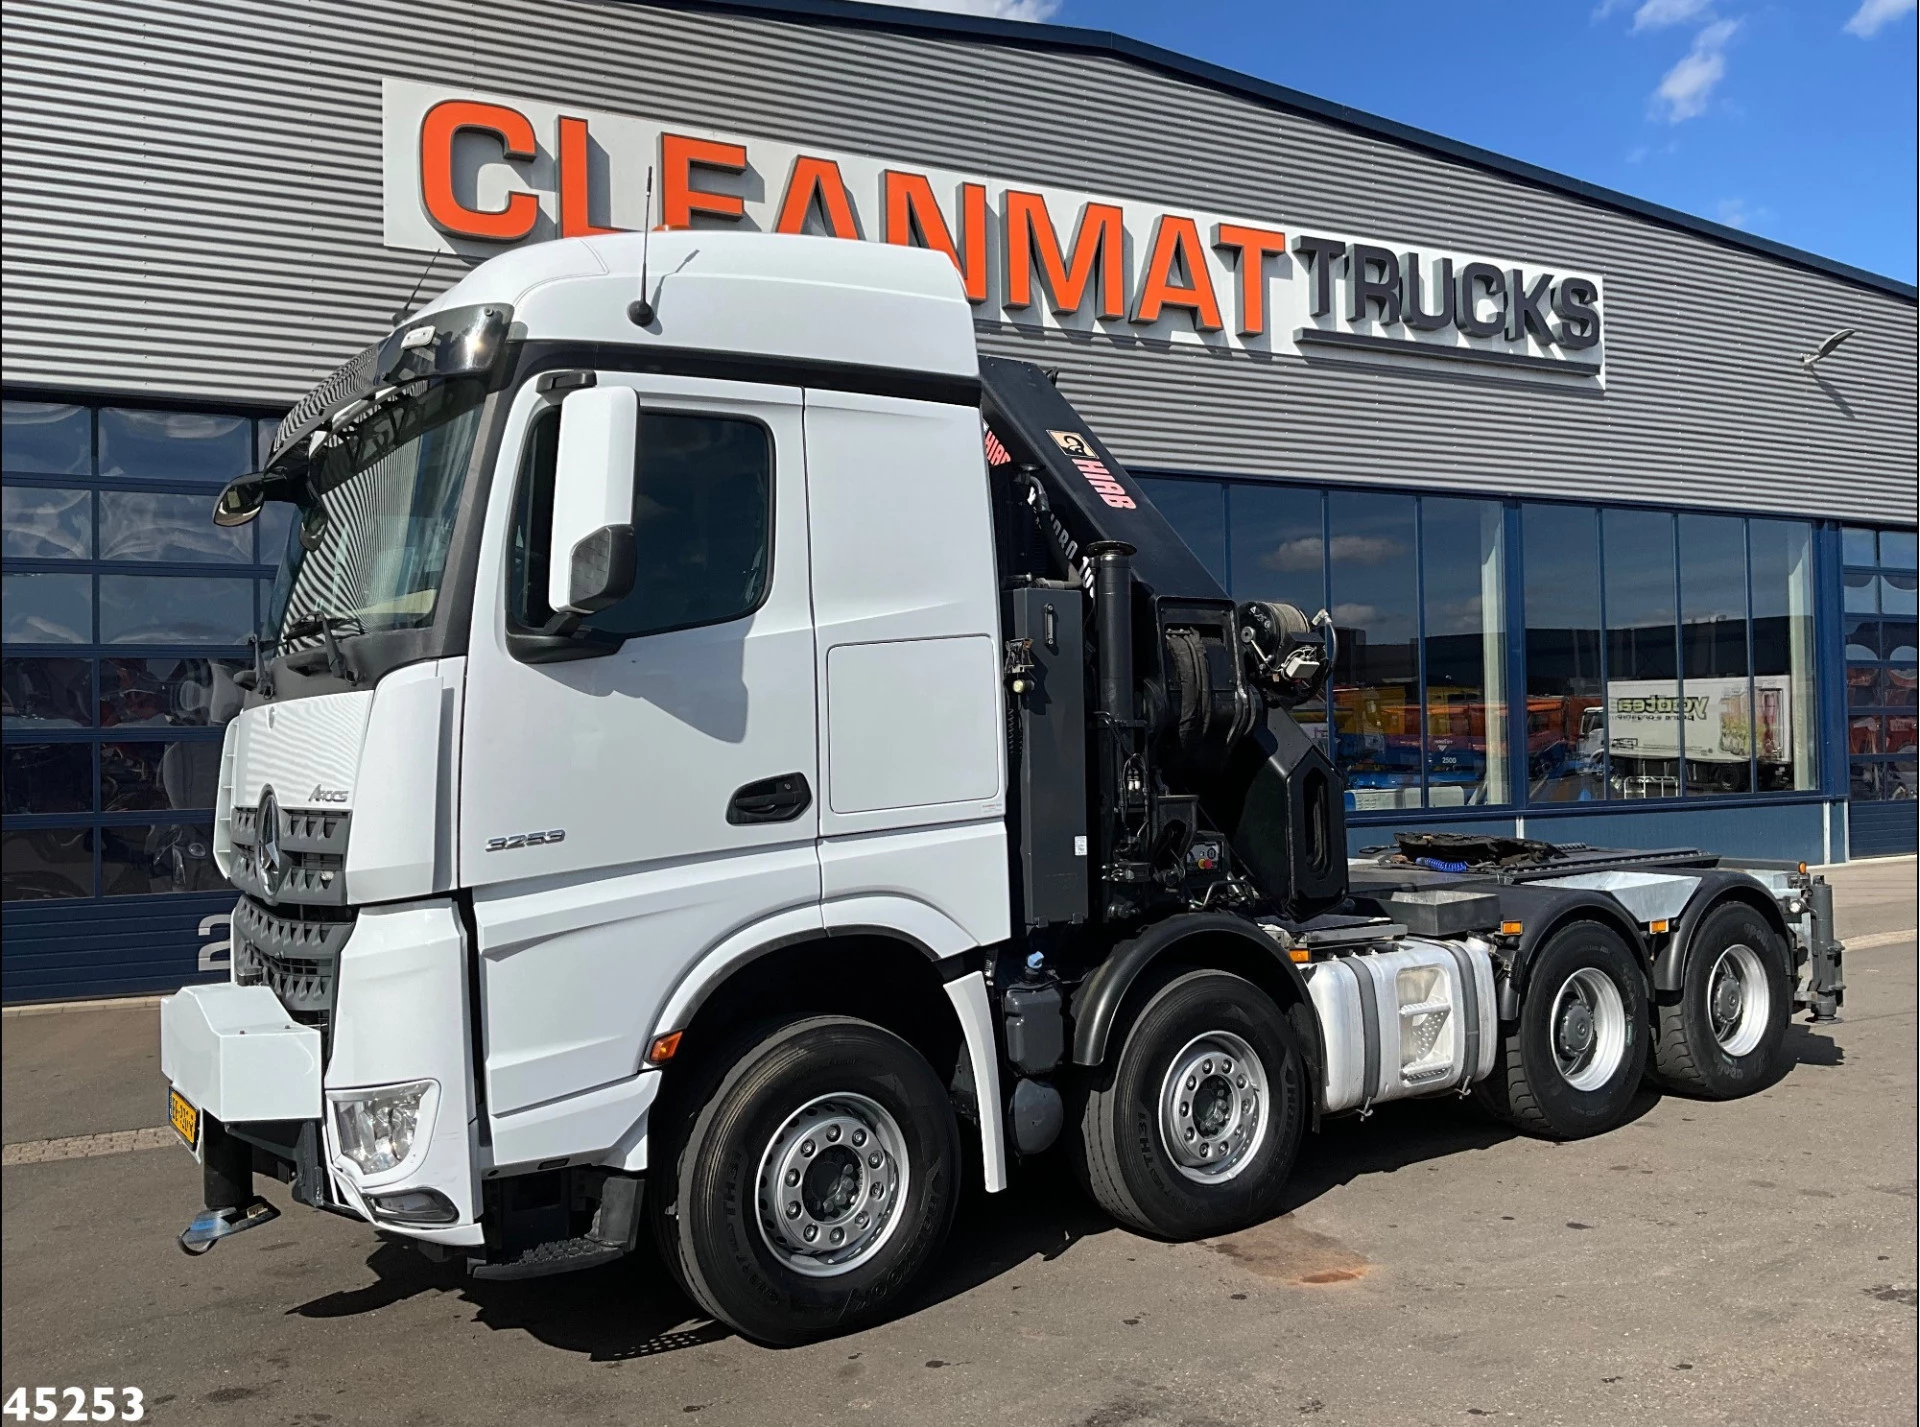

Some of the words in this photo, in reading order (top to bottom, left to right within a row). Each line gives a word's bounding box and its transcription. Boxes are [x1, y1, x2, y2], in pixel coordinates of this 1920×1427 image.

[420, 98, 1286, 336] CLEANMAT
[1294, 234, 1600, 350] TRUCKS
[1071, 458, 1137, 510] HIAB
[1441, 756, 1457, 764] 2500
[485, 828, 567, 852] 3253
[198, 914, 232, 971] 2
